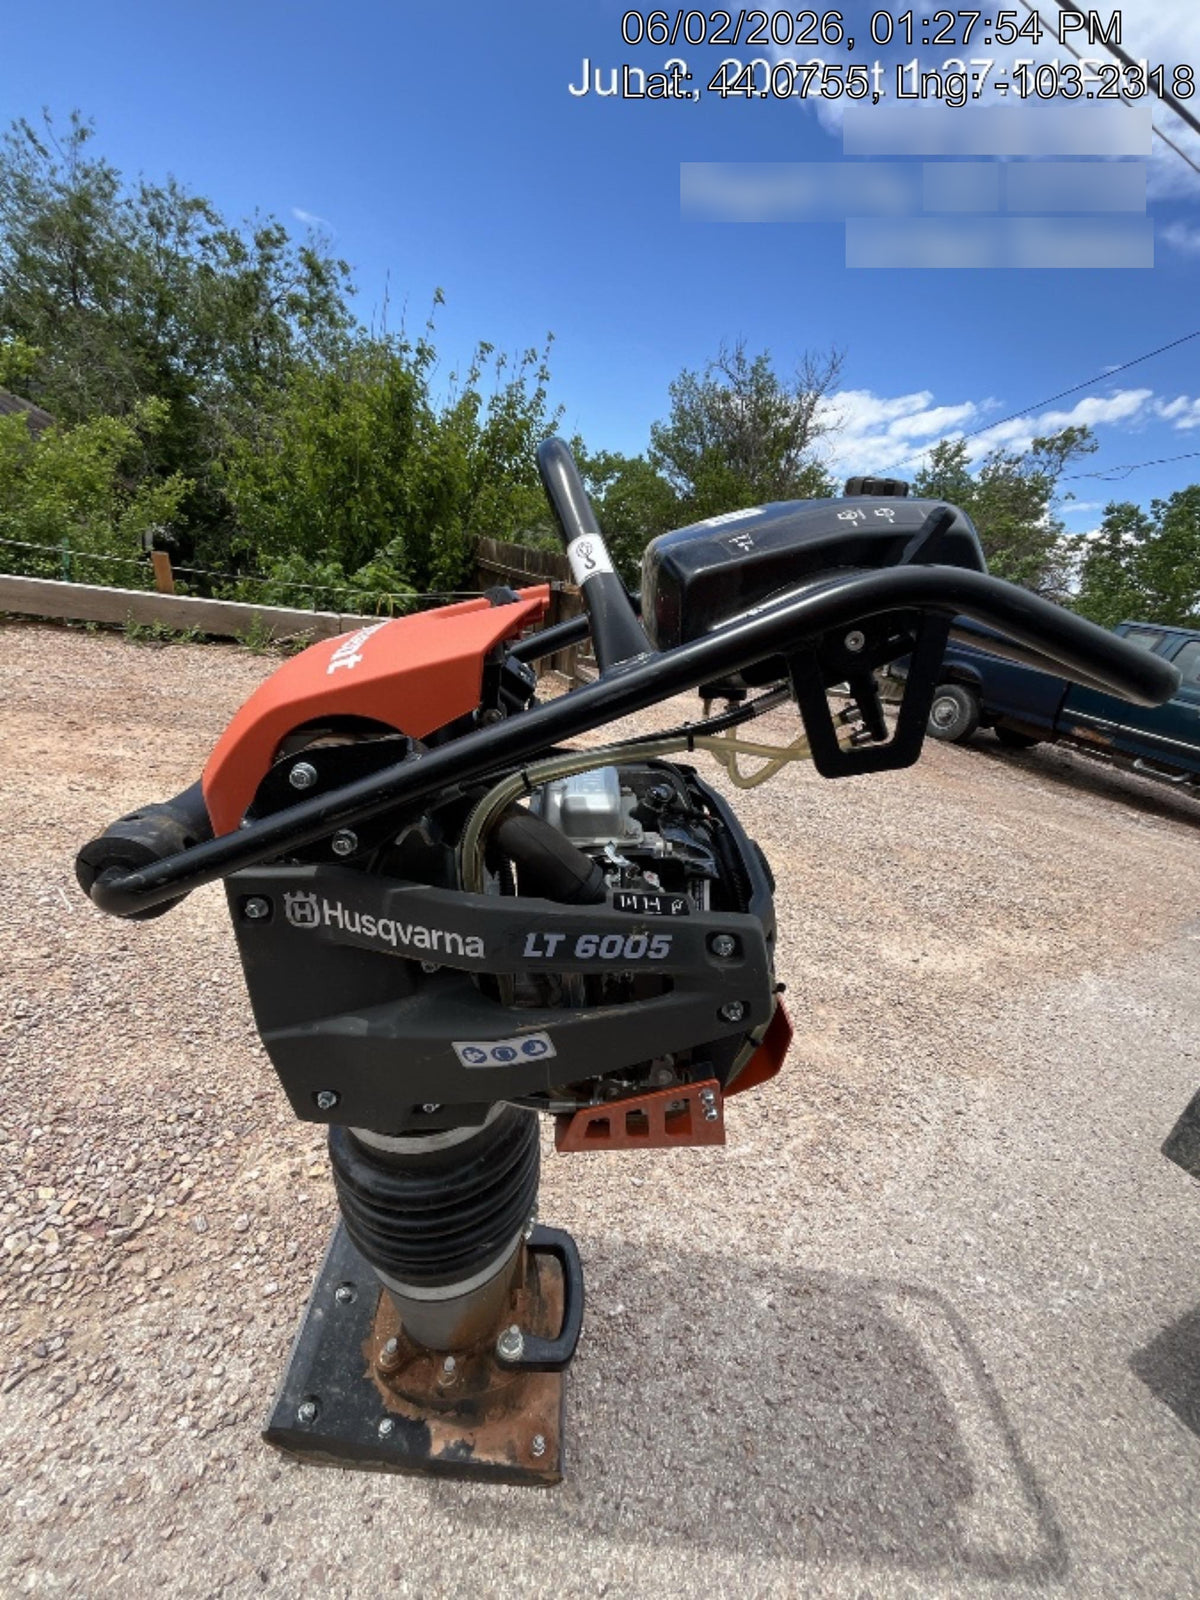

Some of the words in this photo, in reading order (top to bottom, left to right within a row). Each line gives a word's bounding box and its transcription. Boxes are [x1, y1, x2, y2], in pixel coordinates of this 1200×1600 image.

[323, 899, 485, 959] Husqvarna
[522, 932, 566, 958] LT
[574, 934, 673, 959] 6005
